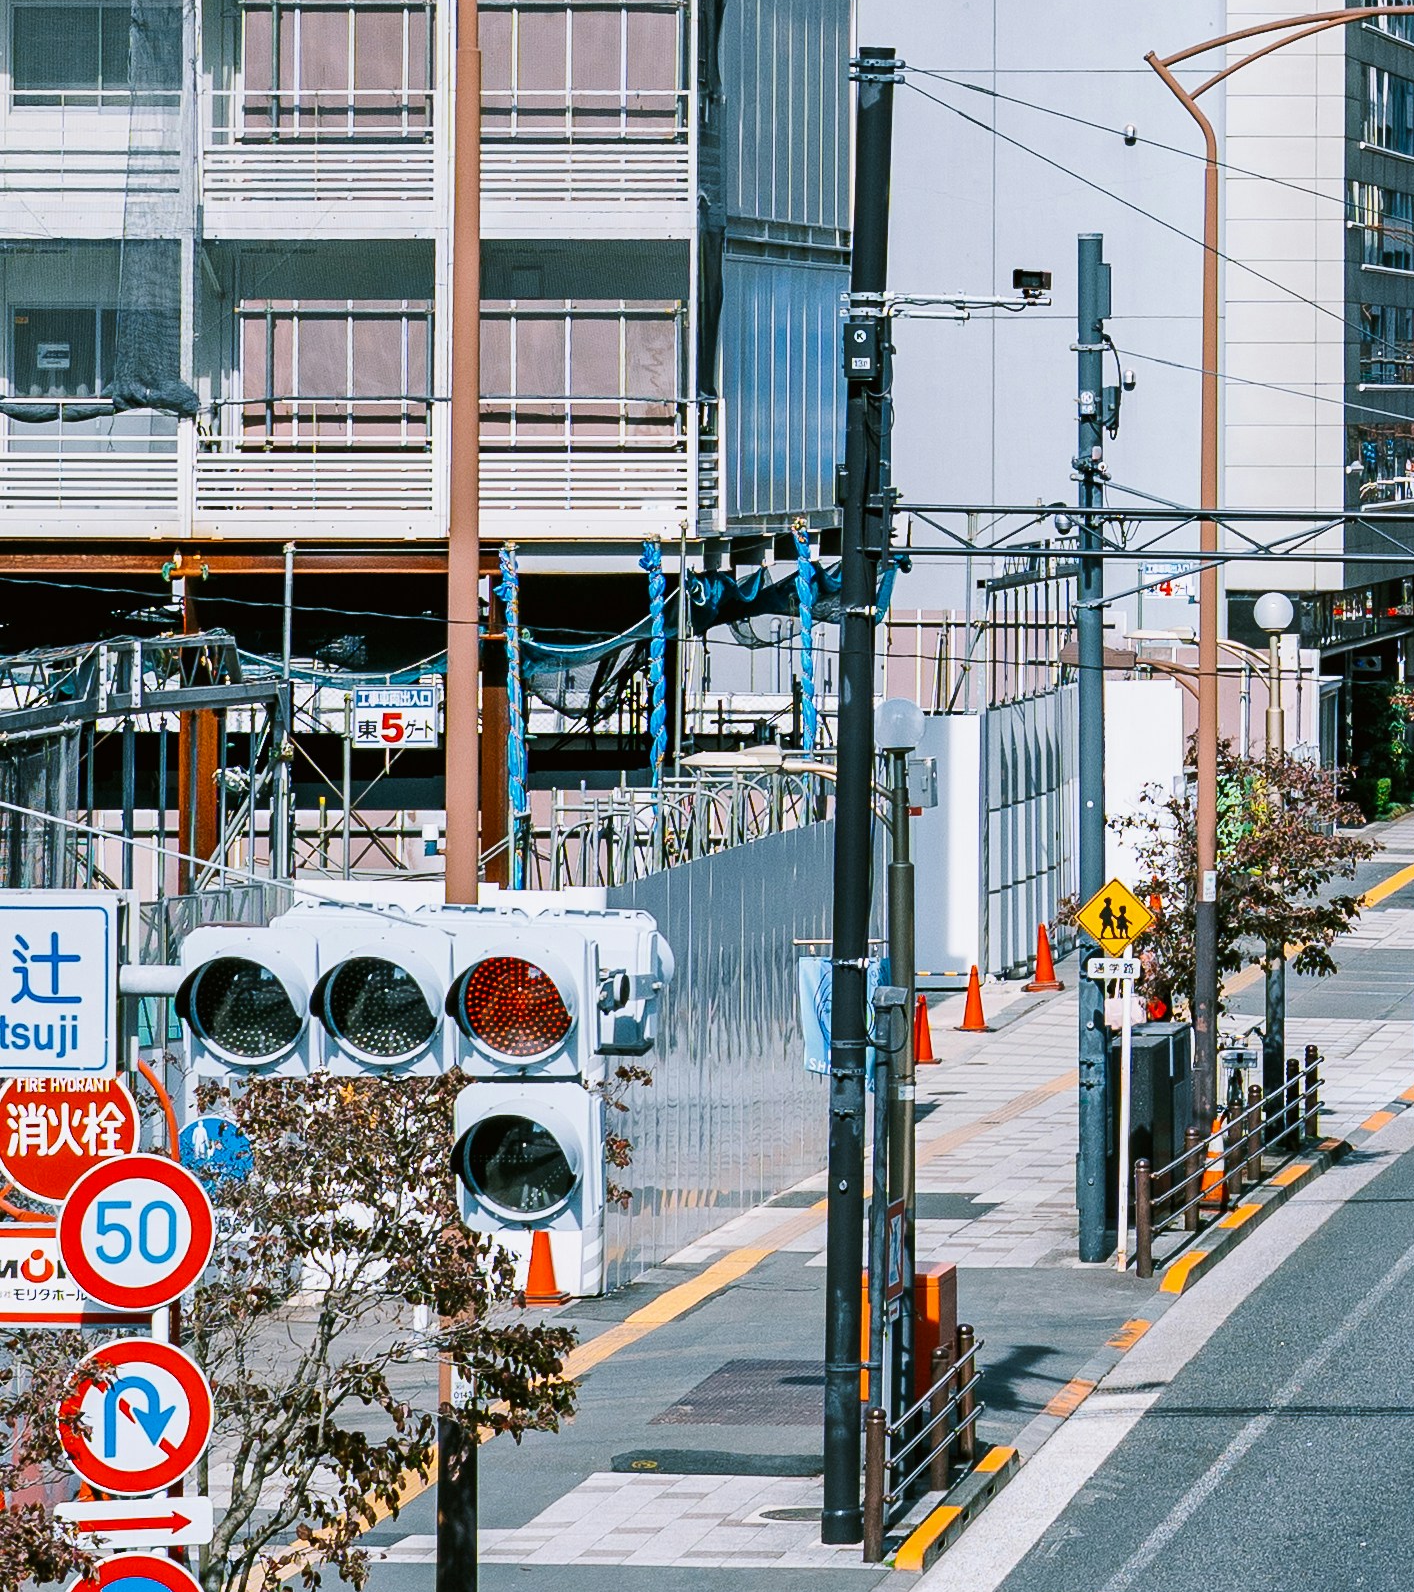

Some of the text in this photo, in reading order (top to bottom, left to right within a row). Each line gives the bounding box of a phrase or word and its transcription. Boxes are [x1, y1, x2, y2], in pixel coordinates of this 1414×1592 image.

[11, 931, 82, 1004] 辻
[17, 1079, 112, 1093] FIRE HYDRANT
[6, 1102, 127, 1157] 消火栓
[96, 1200, 177, 1264] 50
